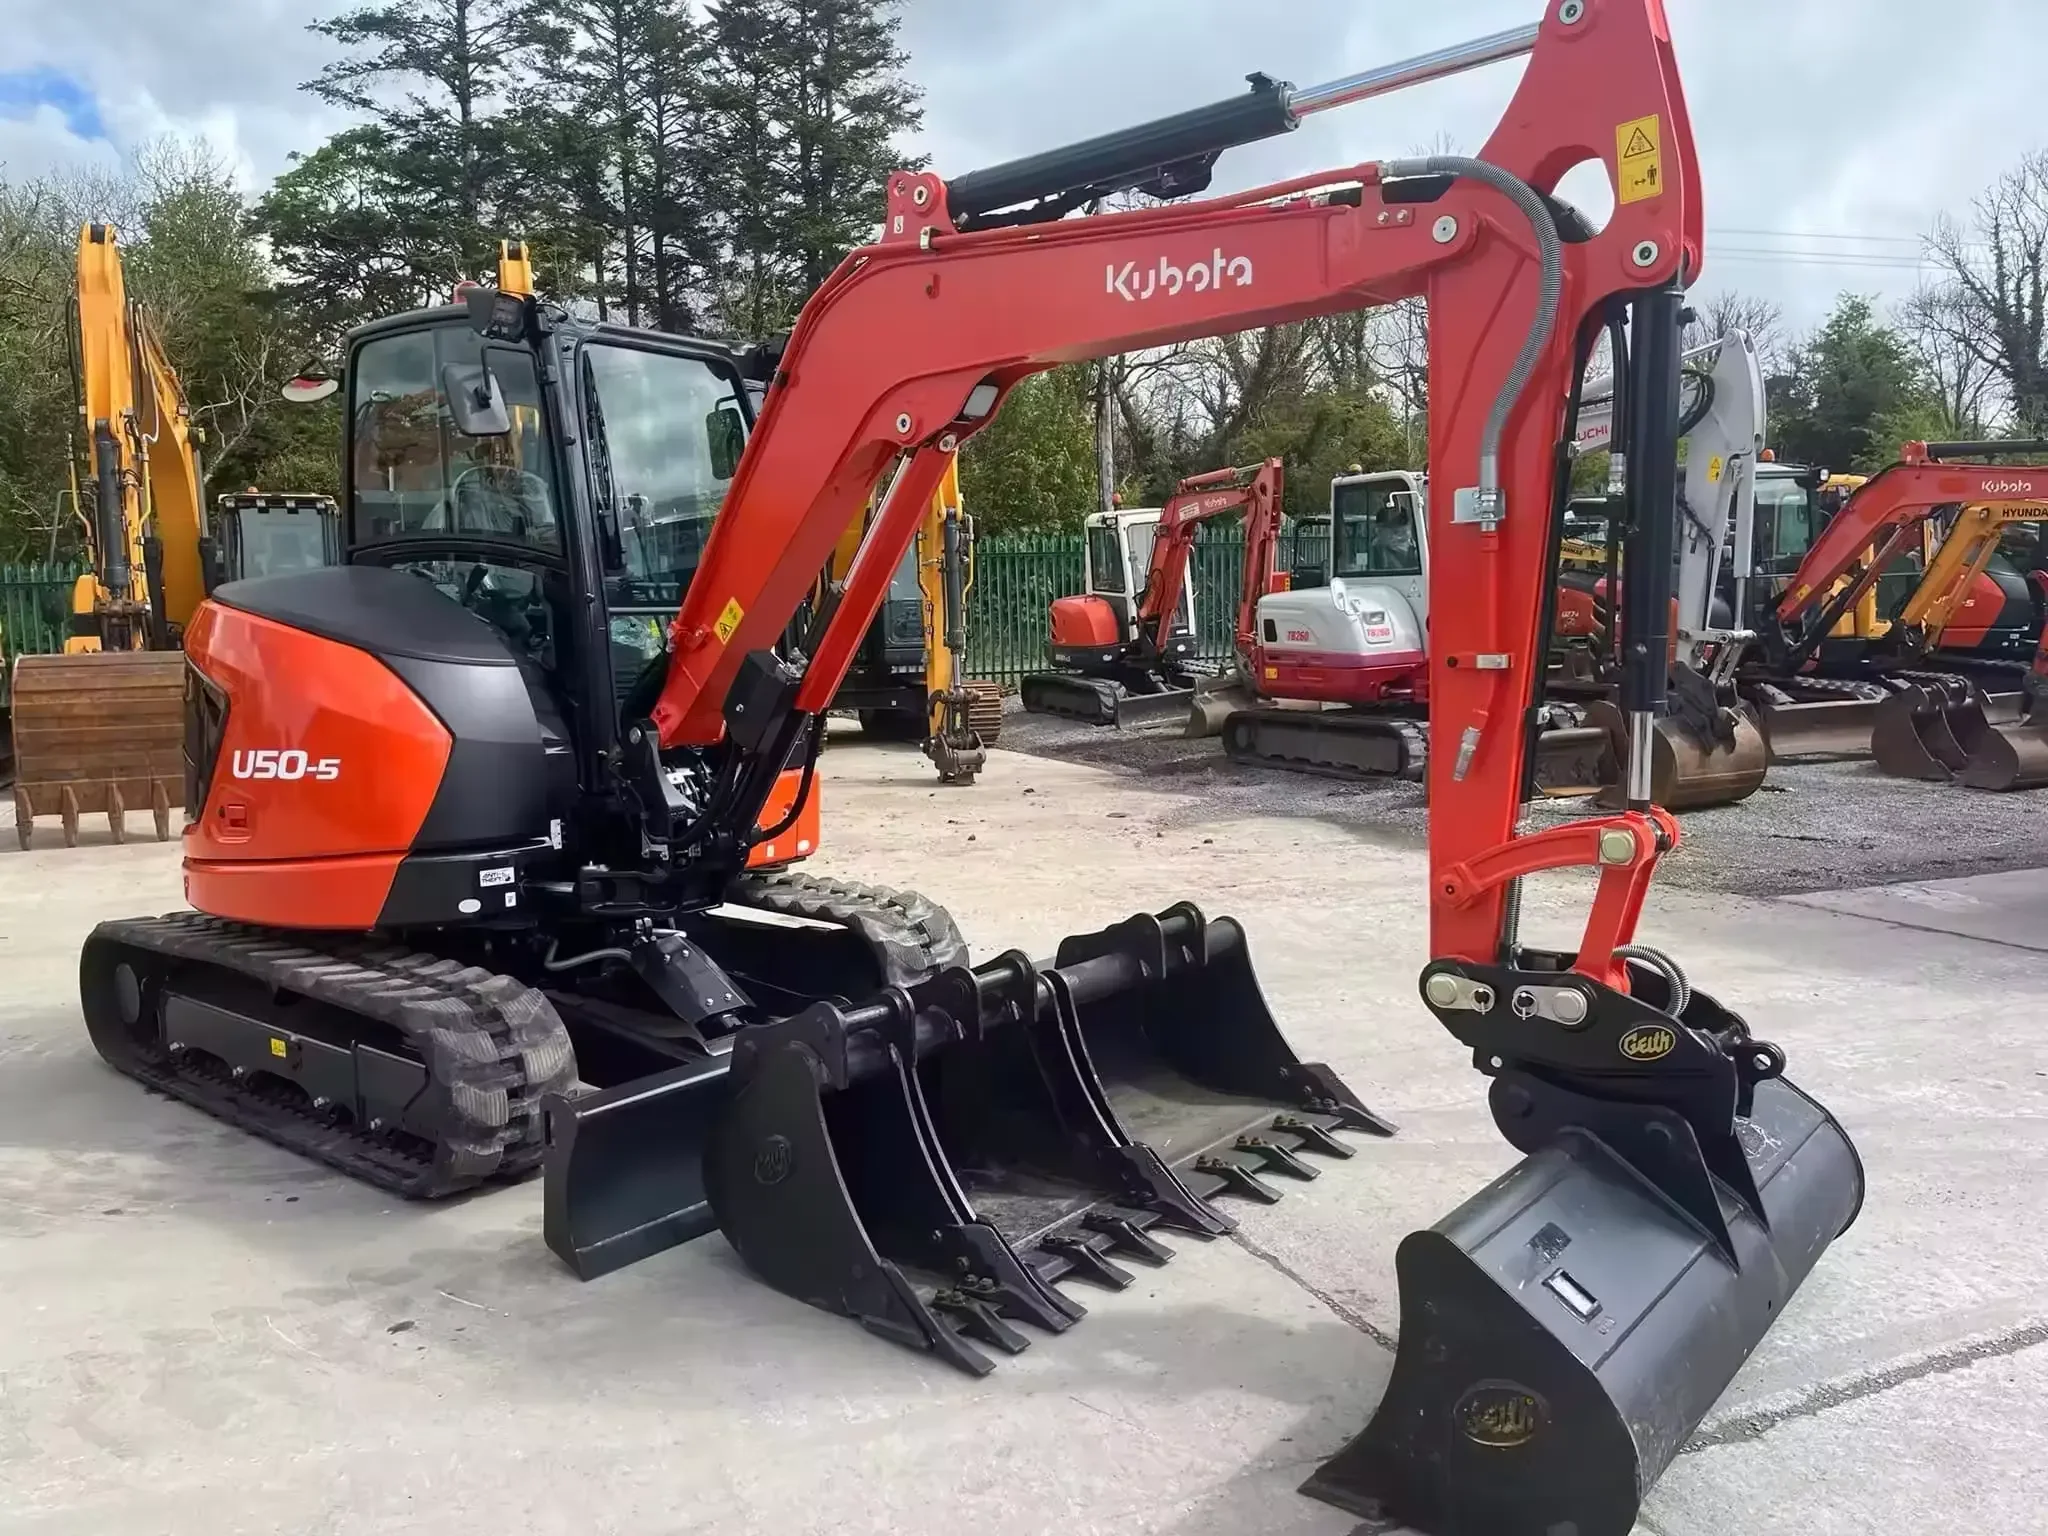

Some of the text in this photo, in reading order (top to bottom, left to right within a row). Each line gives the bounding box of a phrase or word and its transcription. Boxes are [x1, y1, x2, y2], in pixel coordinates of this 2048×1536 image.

[1106, 248, 1252, 301] Kubota
[1981, 480, 2032, 493] Kubota
[233, 750, 341, 780] U50-5
